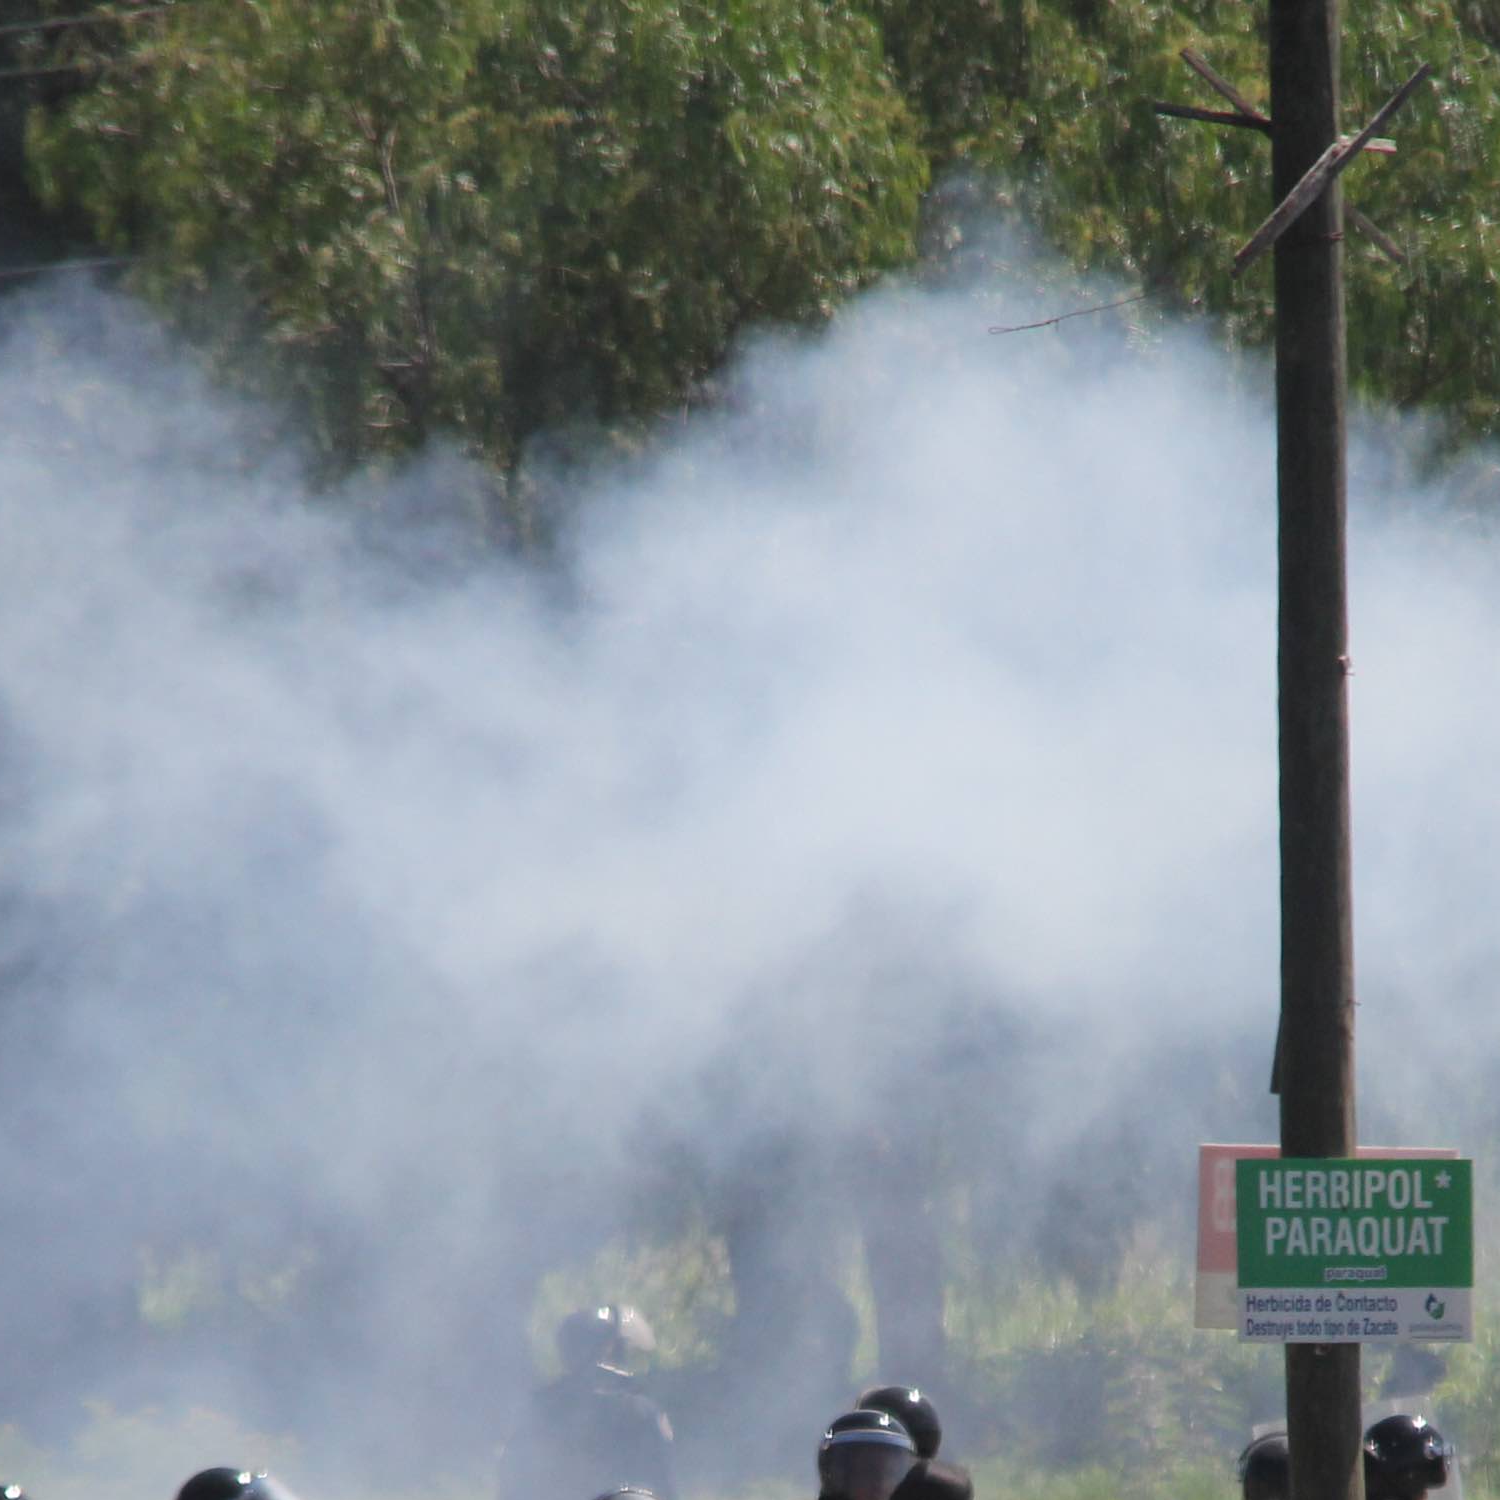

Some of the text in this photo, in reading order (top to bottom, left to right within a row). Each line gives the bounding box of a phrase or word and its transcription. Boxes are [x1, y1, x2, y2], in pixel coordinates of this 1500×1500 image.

[1265, 1217, 1449, 1257] PARAQUAT
[1324, 1265, 1386, 1281] paraquat
[1246, 1293, 1398, 1312] Herbicida de Contacto
[1247, 1318, 1293, 1339] Destruye
[1296, 1319, 1321, 1336] todo
[1323, 1319, 1345, 1338] tipo
[1347, 1319, 1360, 1336] de
[1363, 1318, 1398, 1336] Zacate
